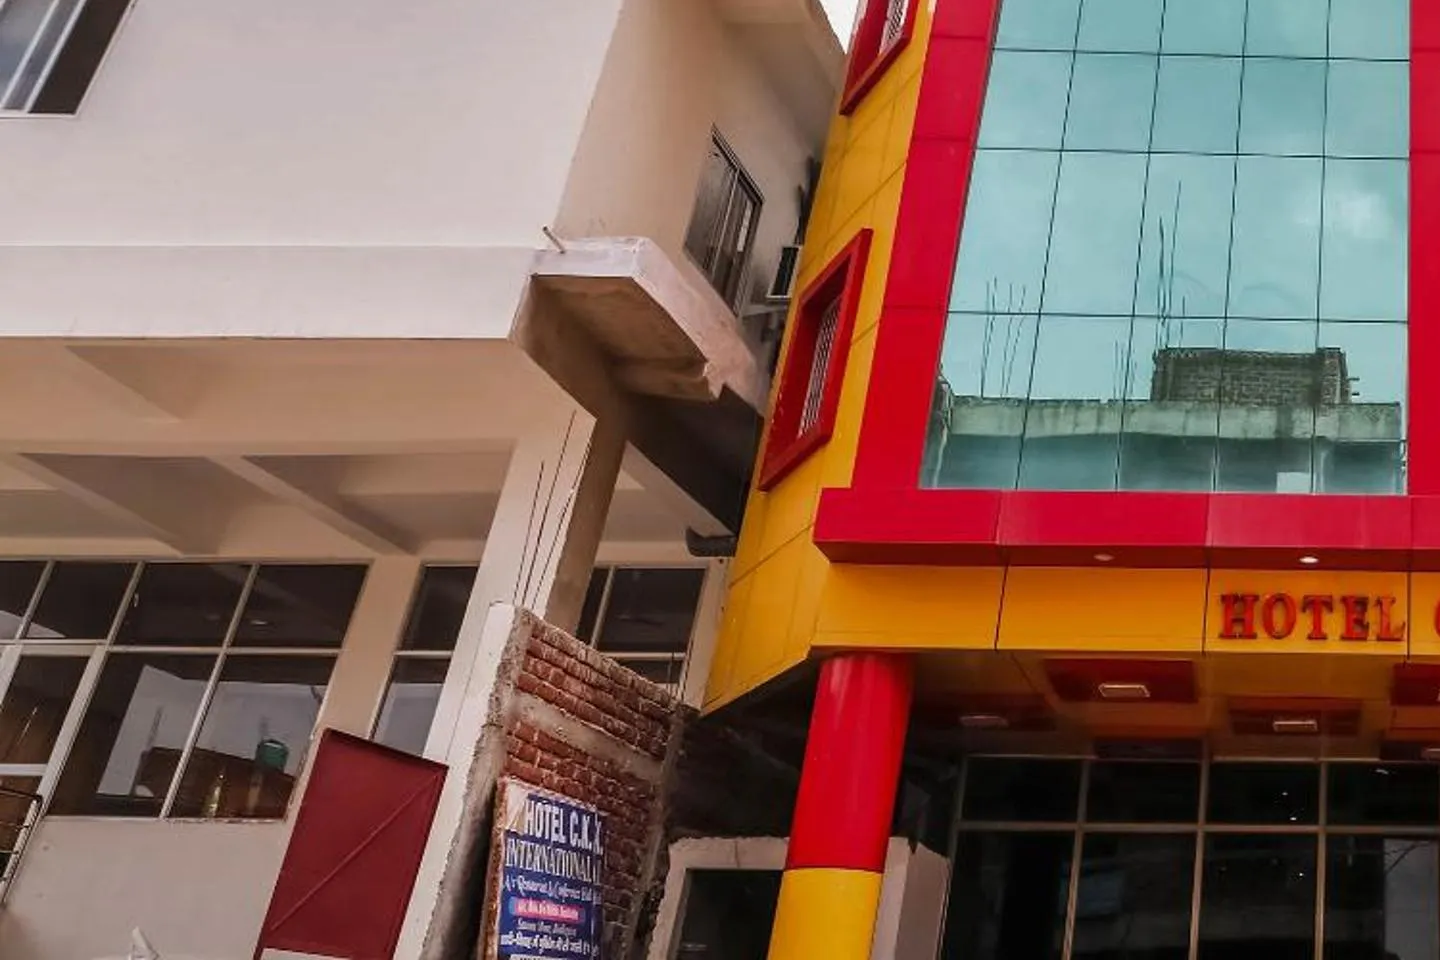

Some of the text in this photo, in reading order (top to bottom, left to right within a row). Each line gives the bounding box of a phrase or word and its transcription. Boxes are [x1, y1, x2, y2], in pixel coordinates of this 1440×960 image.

[1218, 592, 1407, 643] HOTEL
[524, 799, 566, 844] HOTEL
[505, 838, 592, 882] INTERNATIONAL
